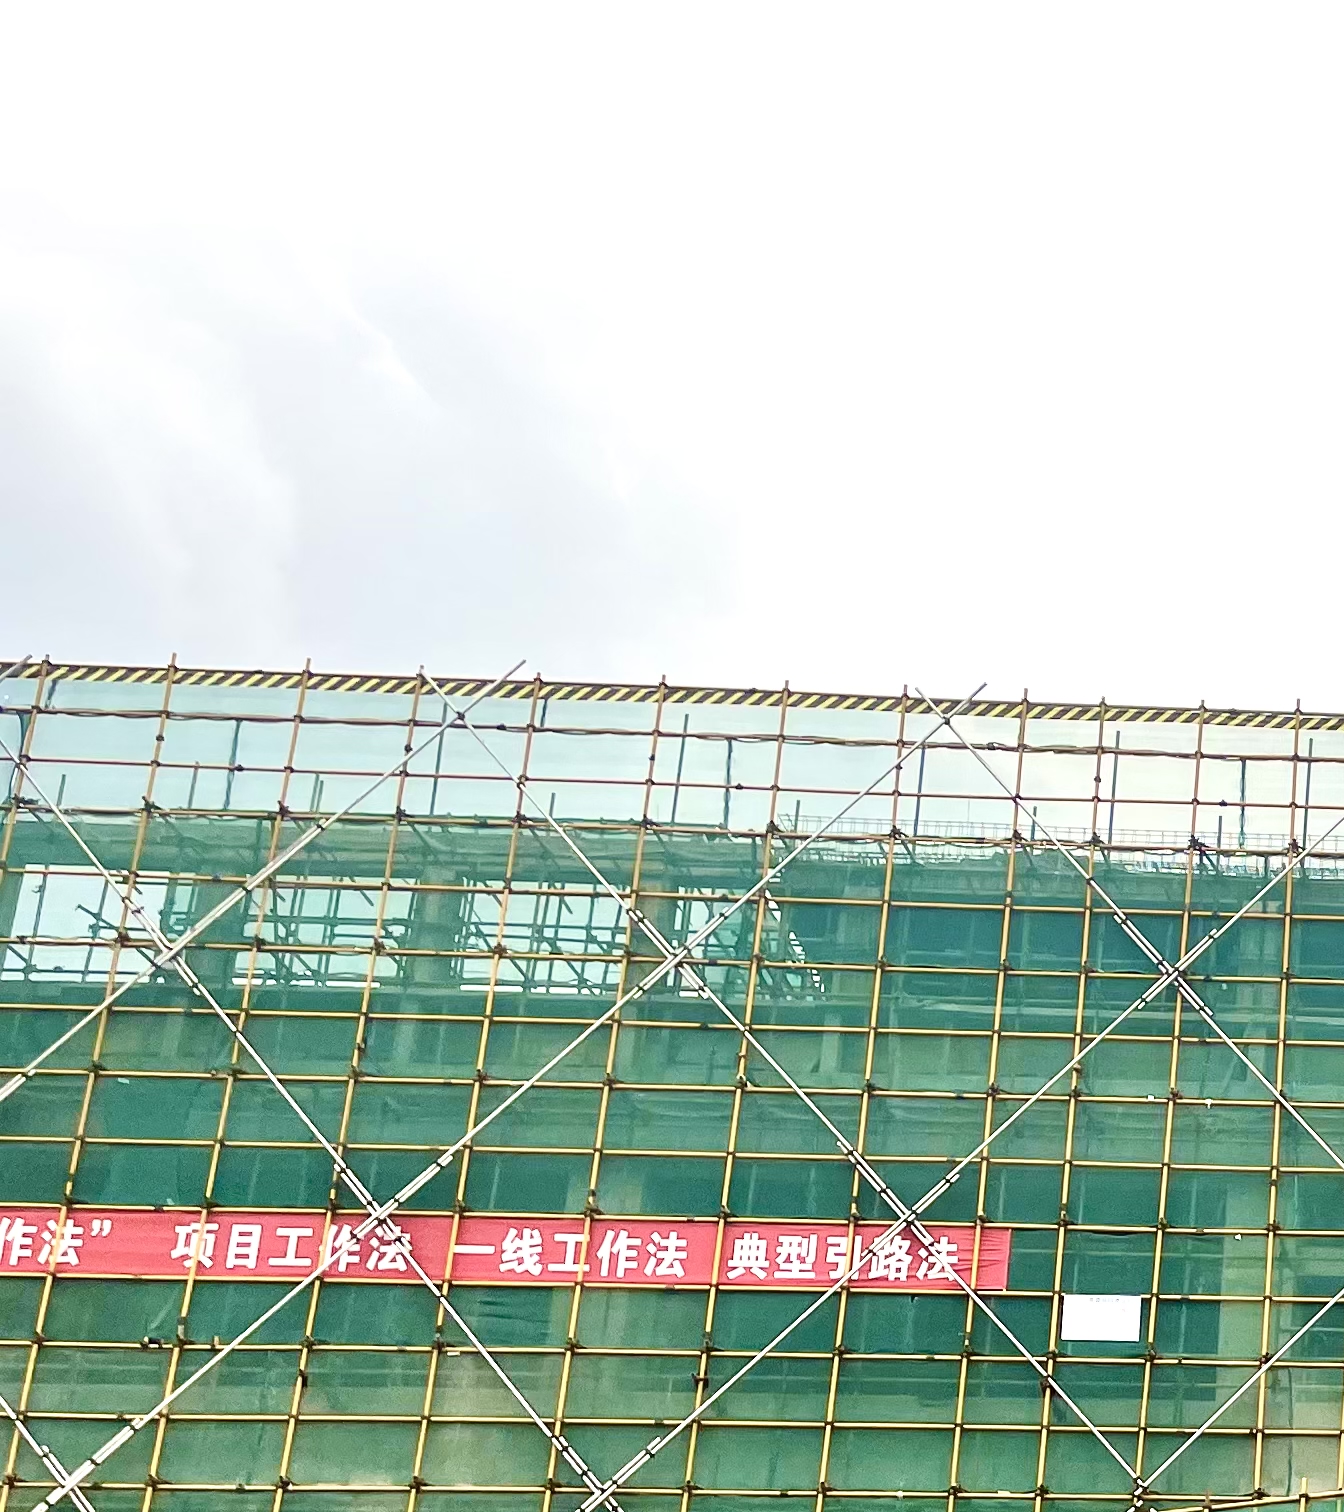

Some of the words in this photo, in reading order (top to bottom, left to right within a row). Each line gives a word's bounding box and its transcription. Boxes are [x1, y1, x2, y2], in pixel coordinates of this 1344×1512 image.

[170, 1220, 413, 1273] 项目工作法
[453, 1227, 689, 1279] 一线工作法
[727, 1231, 959, 1283] 典型引路法
